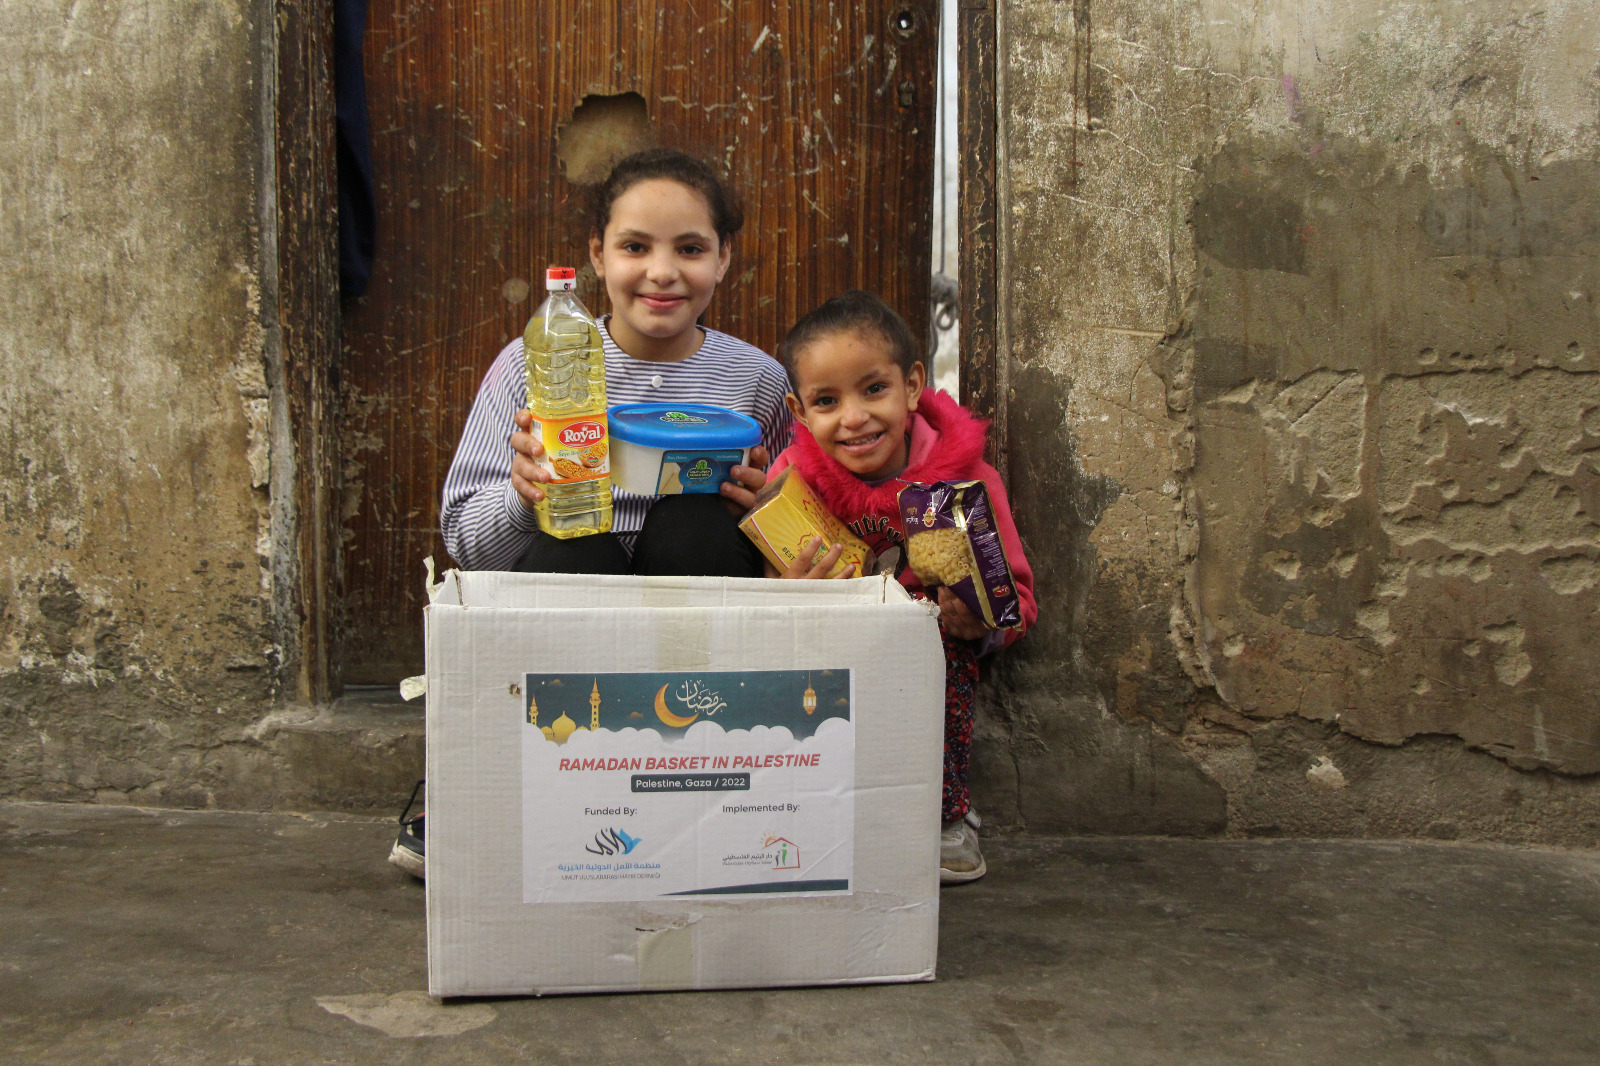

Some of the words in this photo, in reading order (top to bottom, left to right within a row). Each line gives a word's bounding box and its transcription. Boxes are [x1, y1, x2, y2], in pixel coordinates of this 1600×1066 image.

[564, 426, 600, 443] Royal
[781, 546, 796, 562] BEST
[676, 680, 727, 716] رمضان
[559, 758, 641, 771] RAMADAN
[645, 756, 710, 770] BASKET
[712, 756, 729, 769] IN
[732, 754, 821, 768] PALESTINE
[636, 779, 683, 789] Palestine,
[685, 779, 712, 787] Gaza
[714, 778, 720, 788] /
[721, 778, 746, 787] 2022
[584, 807, 621, 816] Funded
[623, 807, 637, 816] By:
[722, 804, 785, 815] Implemented
[787, 803, 800, 813] By:
[558, 863, 584, 872] الخيرية
